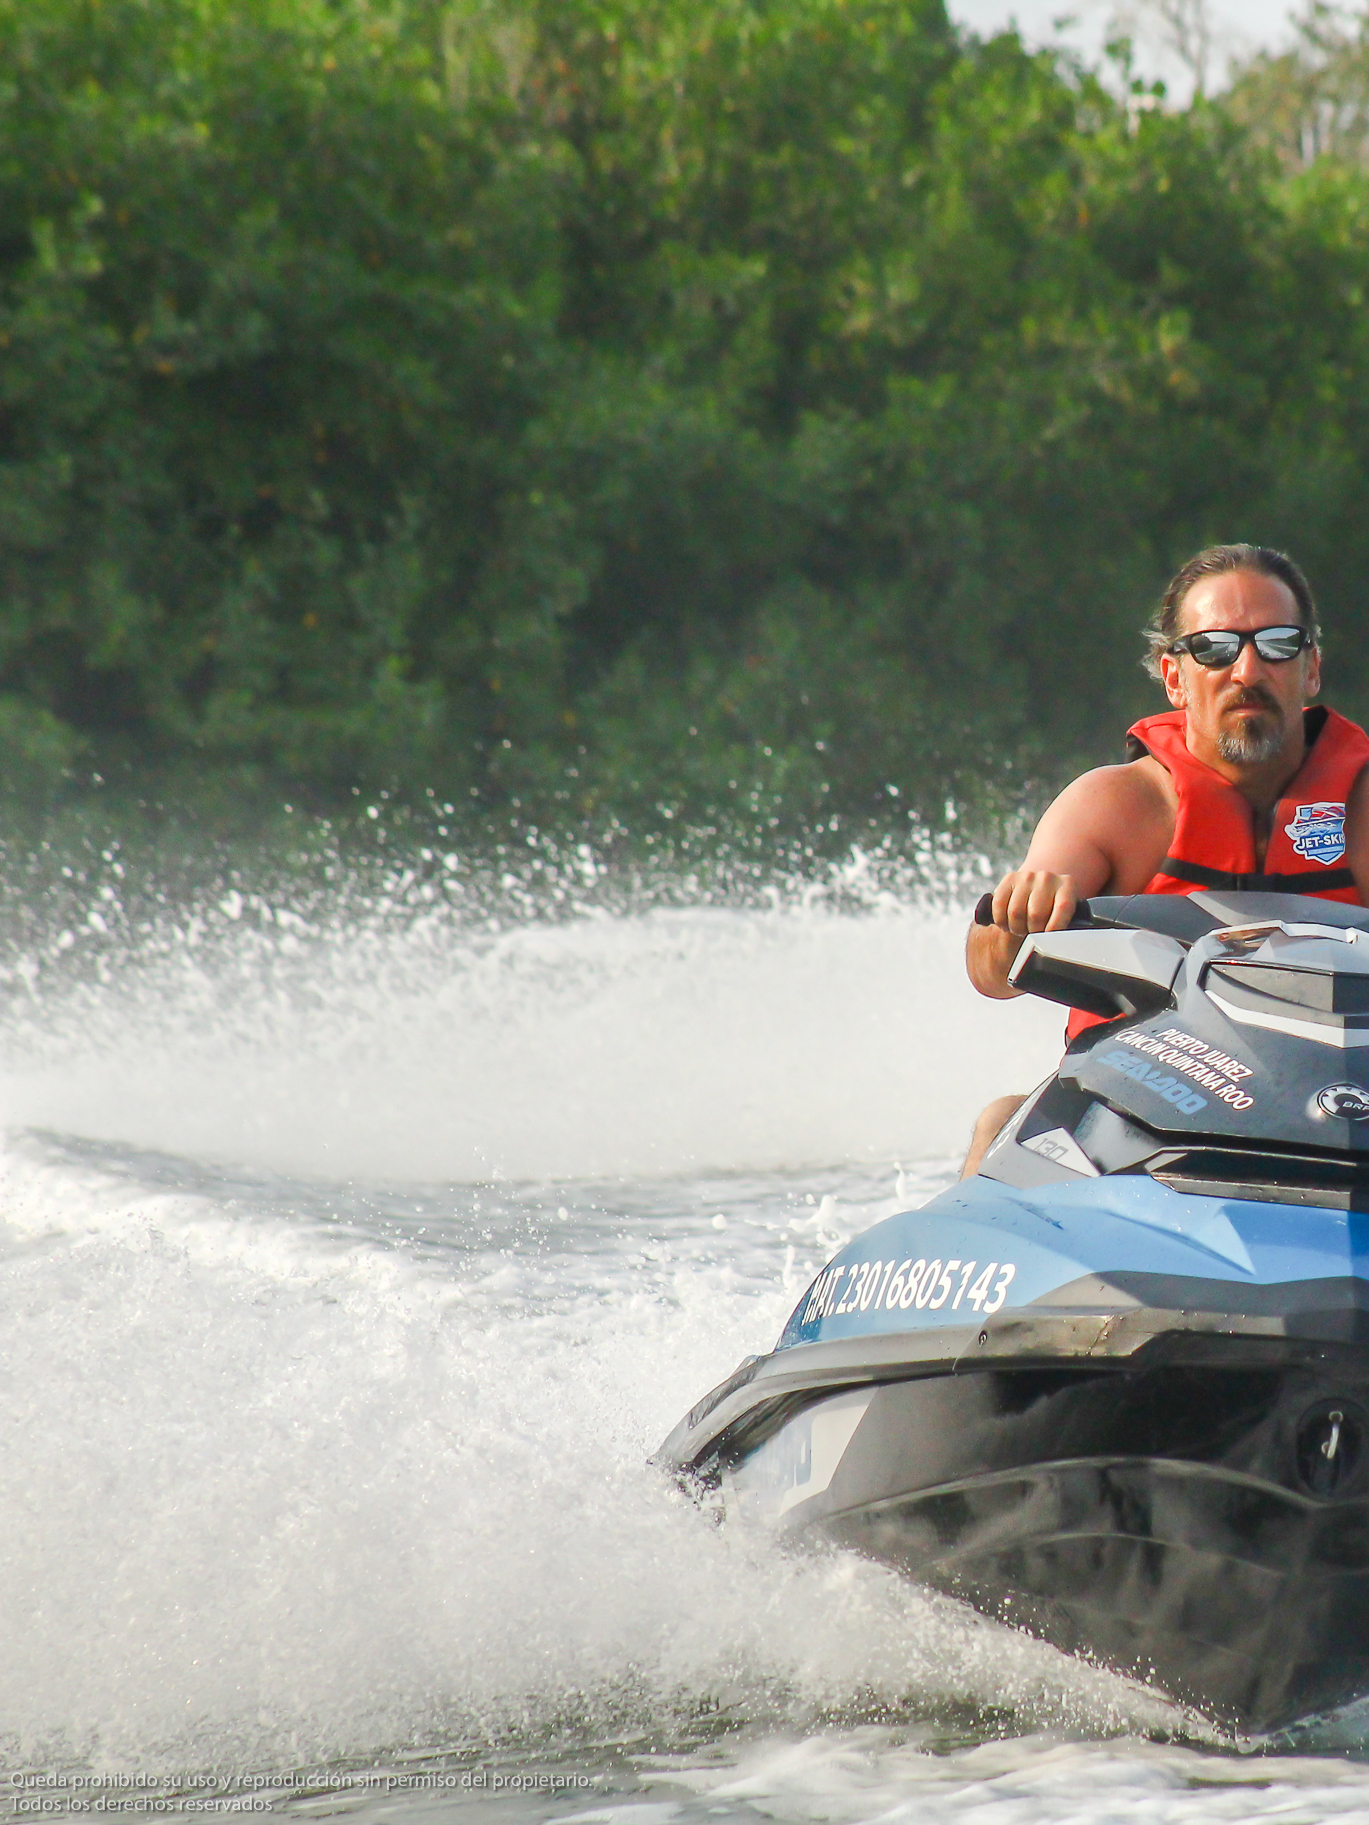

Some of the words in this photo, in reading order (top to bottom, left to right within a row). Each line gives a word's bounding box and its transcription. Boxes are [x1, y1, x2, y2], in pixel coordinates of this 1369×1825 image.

[1114, 1030, 1168, 1056] CANCUN
[1157, 1048, 1227, 1091] QUINTANA
[1214, 1083, 1256, 1110] ROO
[1155, 1028, 1210, 1055] PUERTO
[1196, 1049, 1254, 1083] JUAREZ
